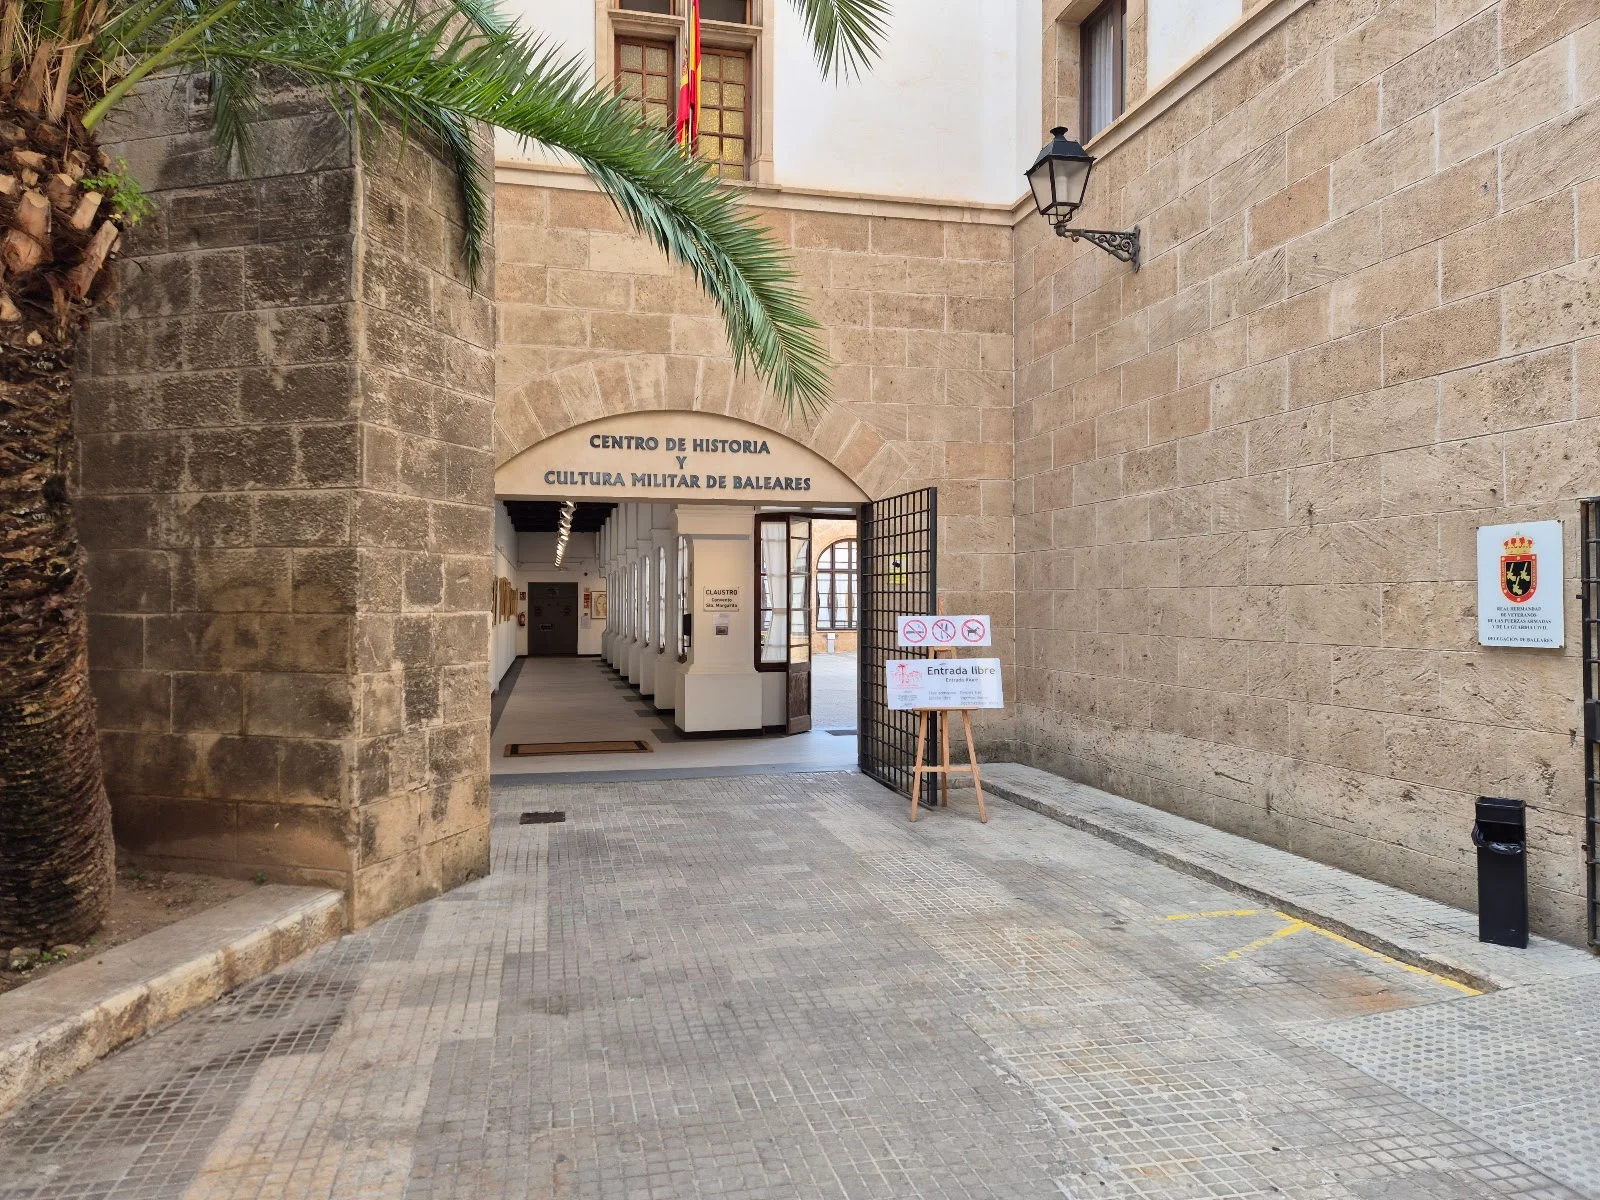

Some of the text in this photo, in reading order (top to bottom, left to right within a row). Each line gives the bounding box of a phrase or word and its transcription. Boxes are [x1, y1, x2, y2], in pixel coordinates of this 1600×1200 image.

[590, 435, 770, 454] CENTRO DE HISTORIA
[676, 456, 687, 469] Y
[544, 471, 811, 491] CULTURA MILITAR DE BALEARES
[927, 665, 996, 676] Entrada libre
